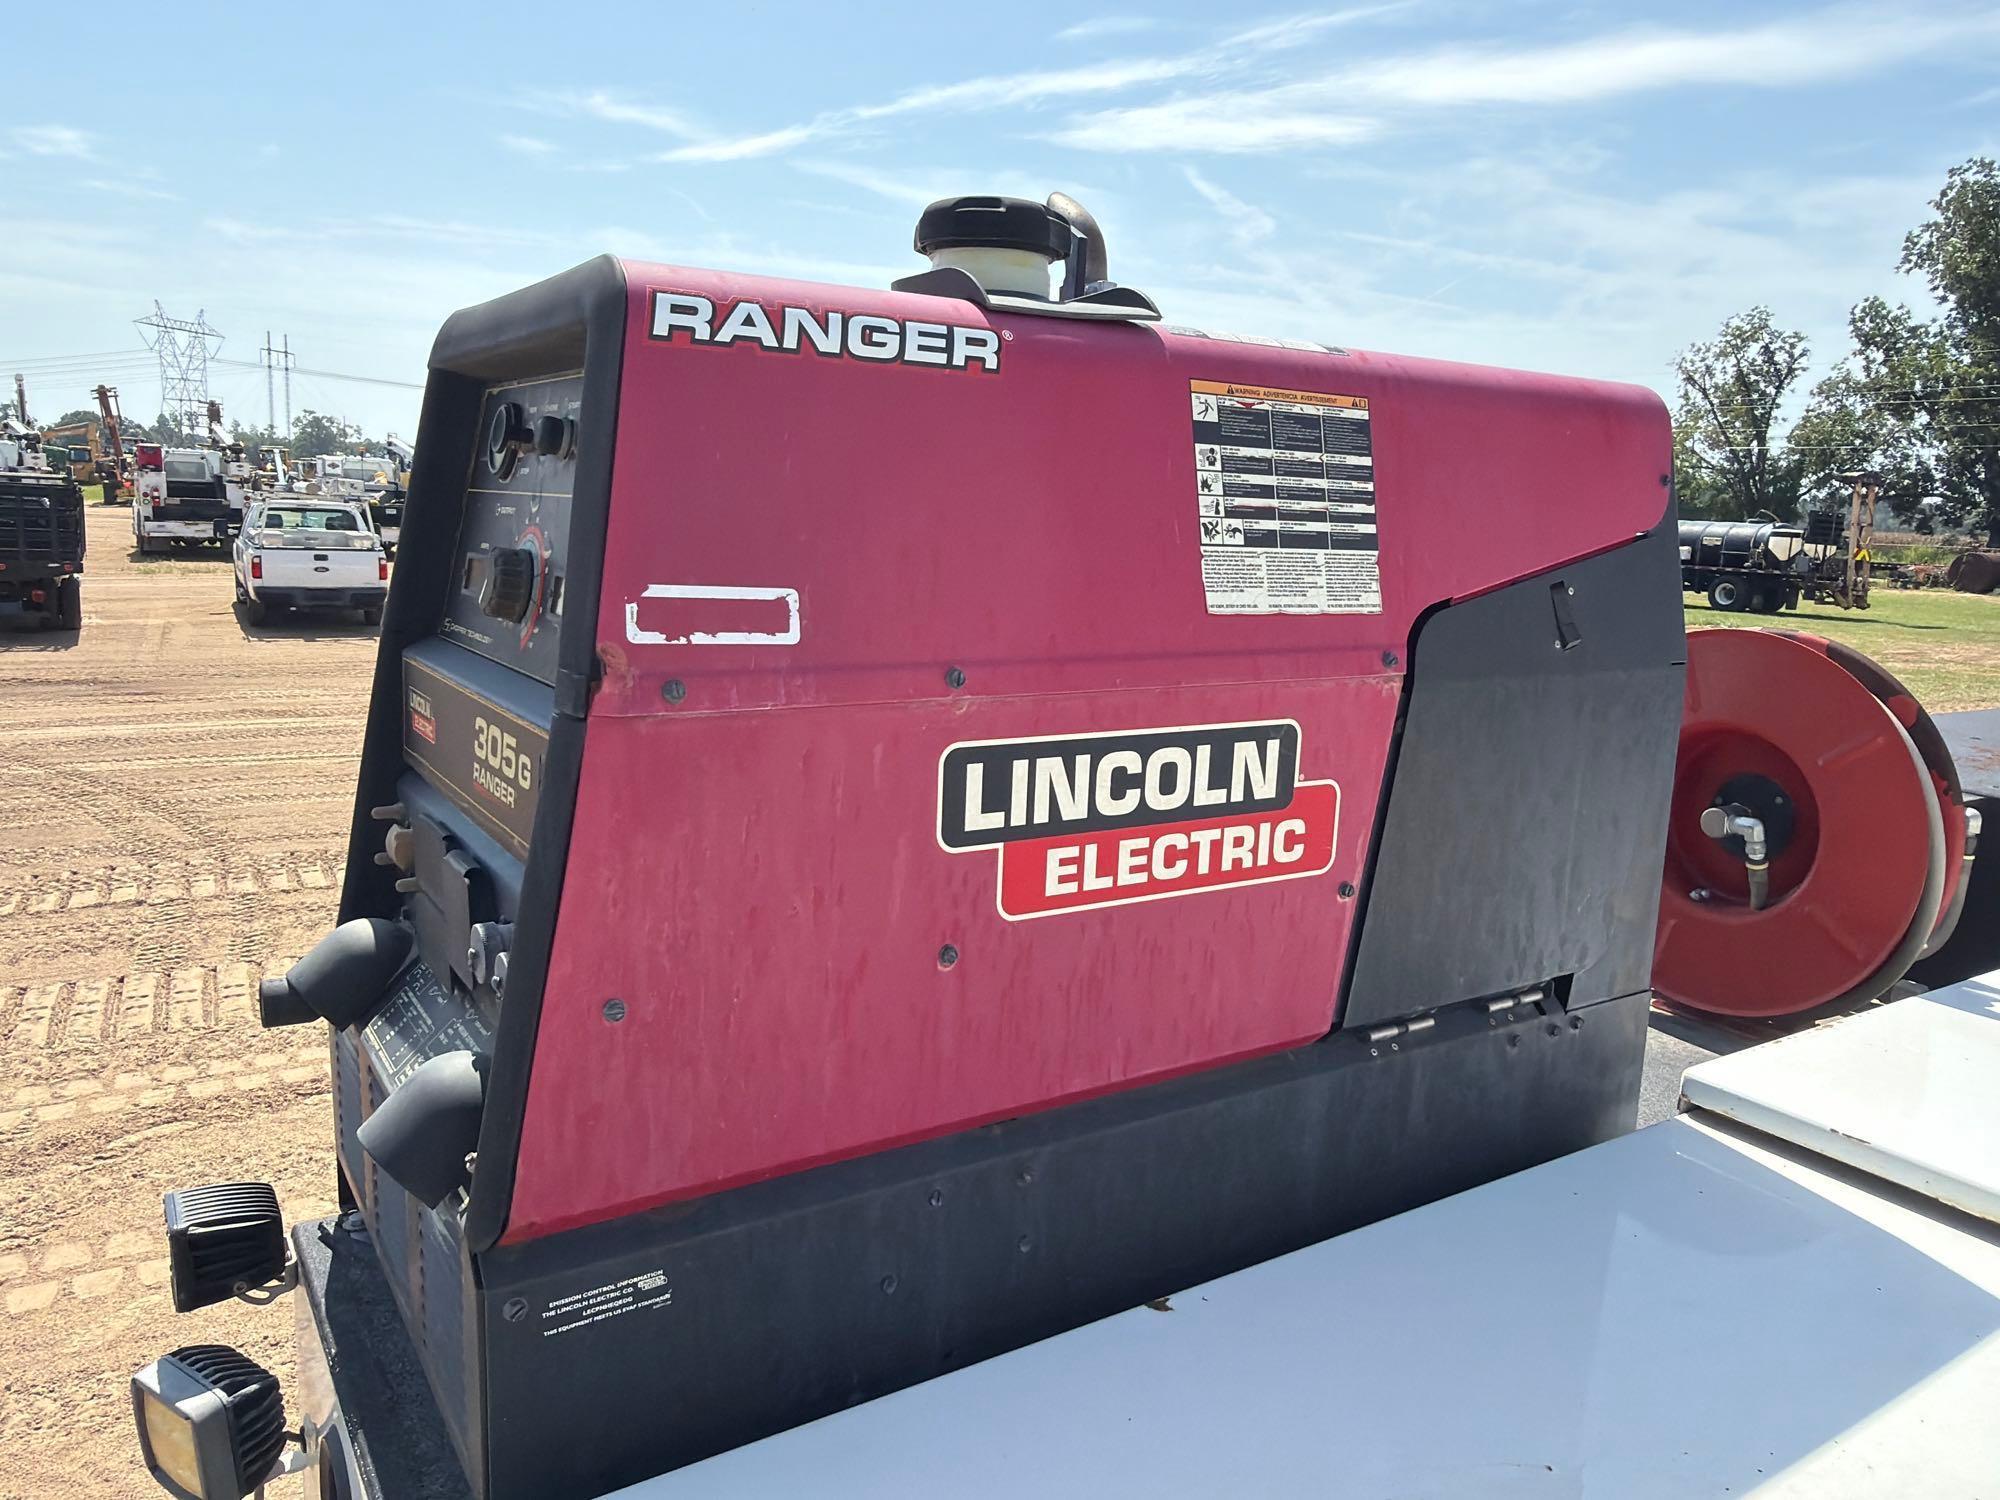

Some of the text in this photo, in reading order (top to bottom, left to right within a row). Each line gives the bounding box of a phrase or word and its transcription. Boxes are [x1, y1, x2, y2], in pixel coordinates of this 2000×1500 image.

[651, 290, 1000, 371] RANGER
[1234, 387, 1261, 397] WARNING
[472, 762, 515, 809] RANGER
[964, 738, 1281, 832] LINCOLN
[1044, 818, 1307, 897] ELECTRIC
[541, 1310, 556, 1319] THE
[557, 1300, 588, 1315] LINCOLN
[589, 1289, 621, 1305] ELECTRIC
[548, 1293, 582, 1308] EMISSION
[582, 1283, 616, 1298] CONTROL
[616, 1269, 664, 1288] INFORMATION
[543, 1328, 557, 1338] THIS
[558, 1317, 593, 1333] EQUIPMENT
[593, 1311, 613, 1322] MEETS
